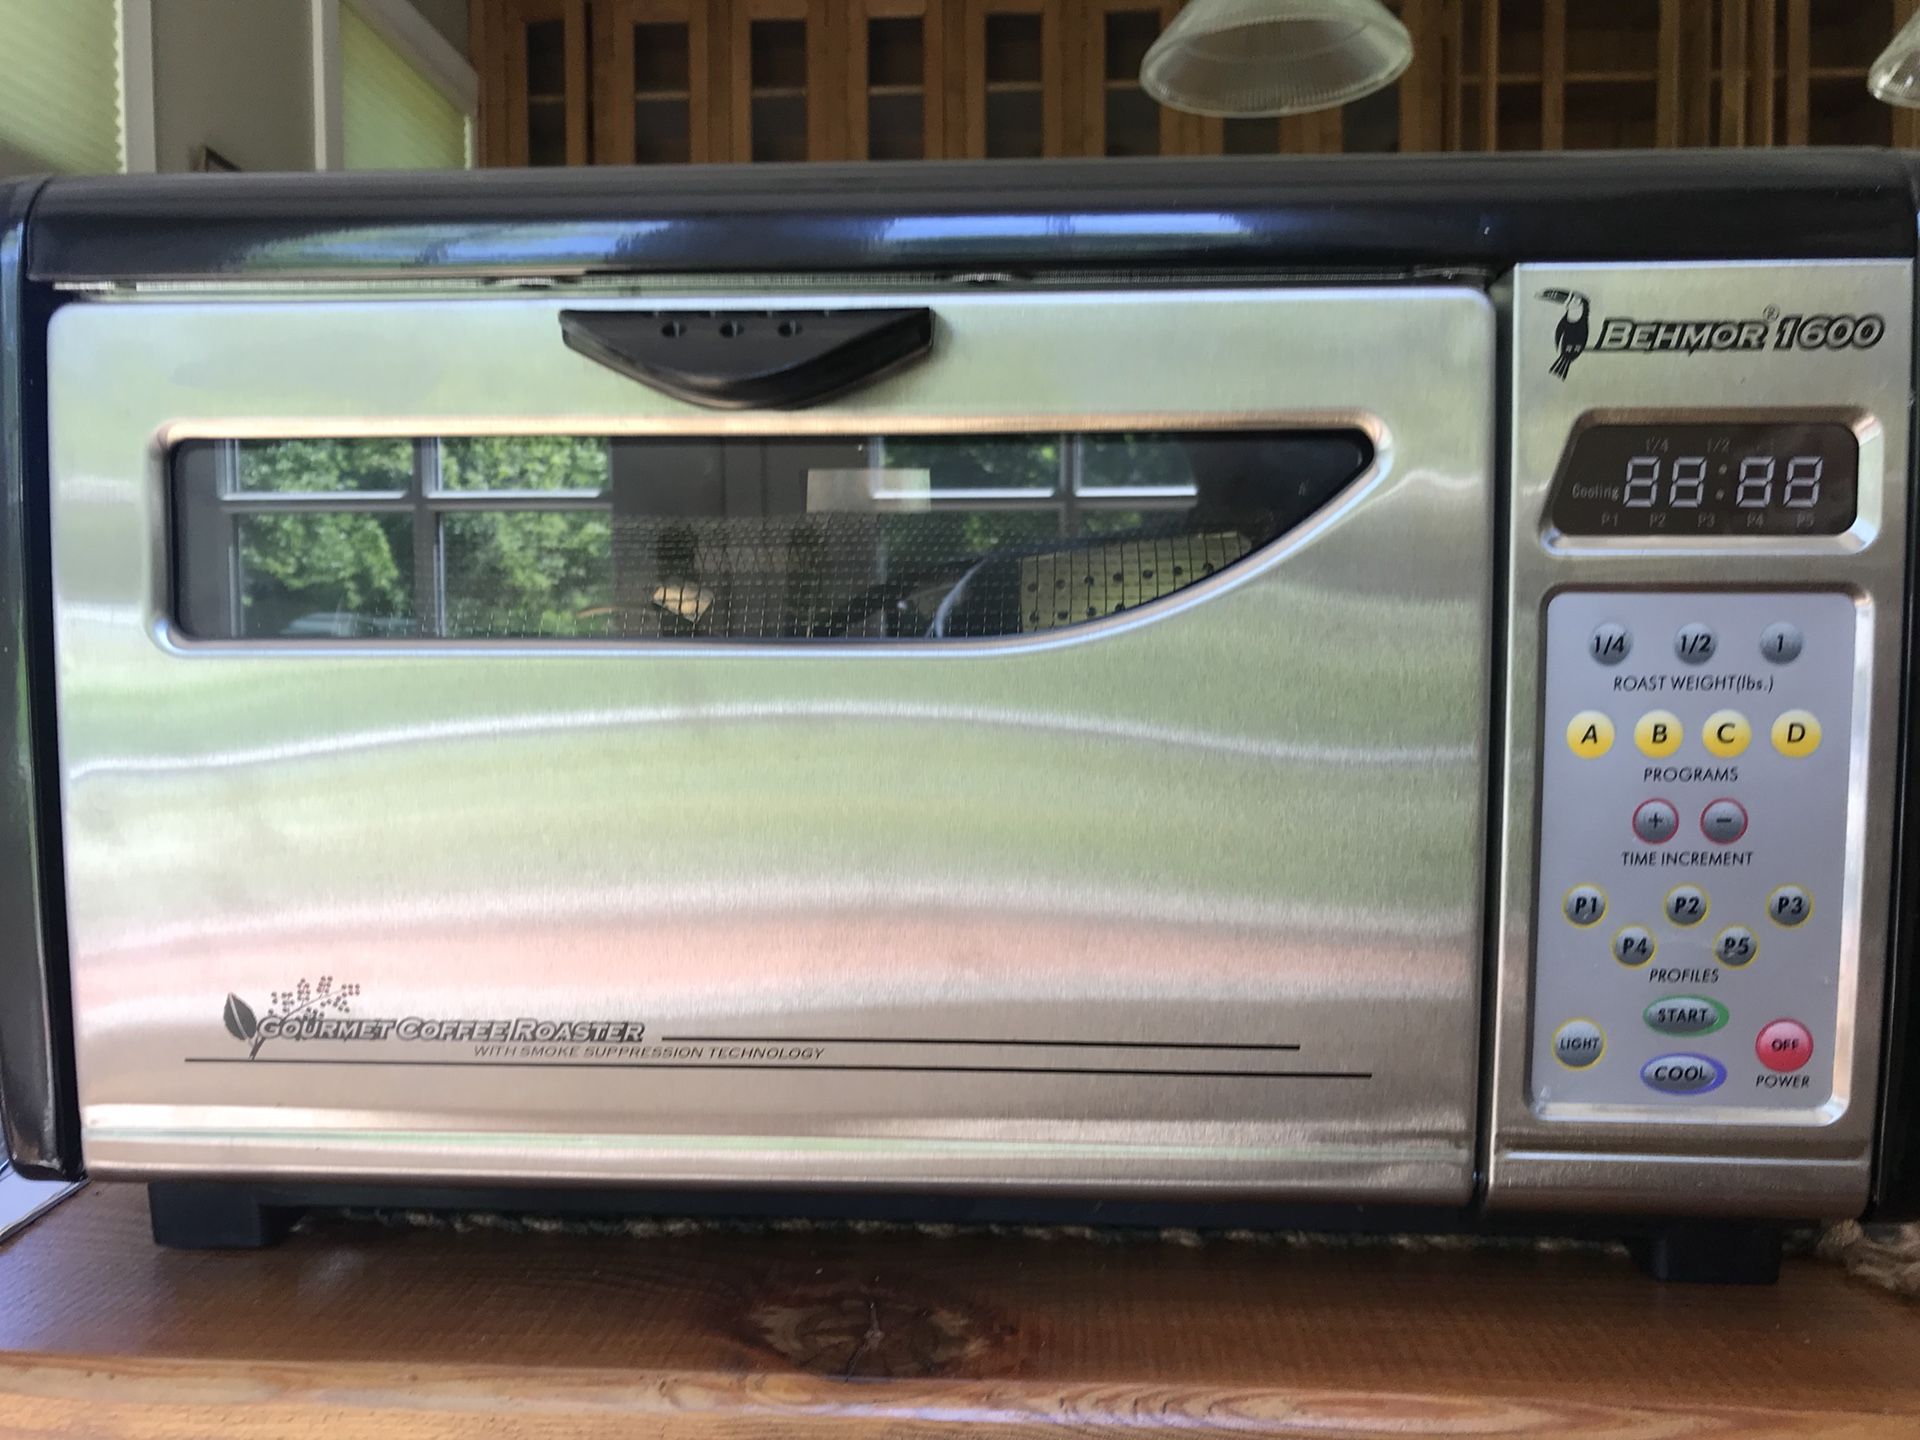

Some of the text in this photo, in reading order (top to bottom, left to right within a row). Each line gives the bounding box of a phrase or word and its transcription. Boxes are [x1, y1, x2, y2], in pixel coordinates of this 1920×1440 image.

[1773, 313, 1885, 350] 1600
[1571, 483, 1620, 501] Cooling
[1593, 634, 1626, 655] 1/4
[1680, 634, 1713, 655] 1/2
[1613, 675, 1667, 693] ROAST
[1580, 722, 1806, 745] A B C D
[1643, 766, 1740, 783] PROGRAMS
[1622, 851, 1753, 867] TIME INCREMENT
[1575, 896, 1802, 915] P1 P2 P3
[1622, 937, 1750, 955] P4 P5
[1649, 967, 1720, 984] PROFILES
[1657, 1006, 1709, 1023] START
[256, 1015, 646, 1043] GOURMET COFFEE ROASTER
[473, 1045, 826, 1061] WITH SMOKE SUPPRESSION TECHNOLOGY
[1560, 1036, 1800, 1052] LIGHT OFF
[1654, 1064, 1708, 1082] COOL
[1755, 1073, 1810, 1088] POWER
